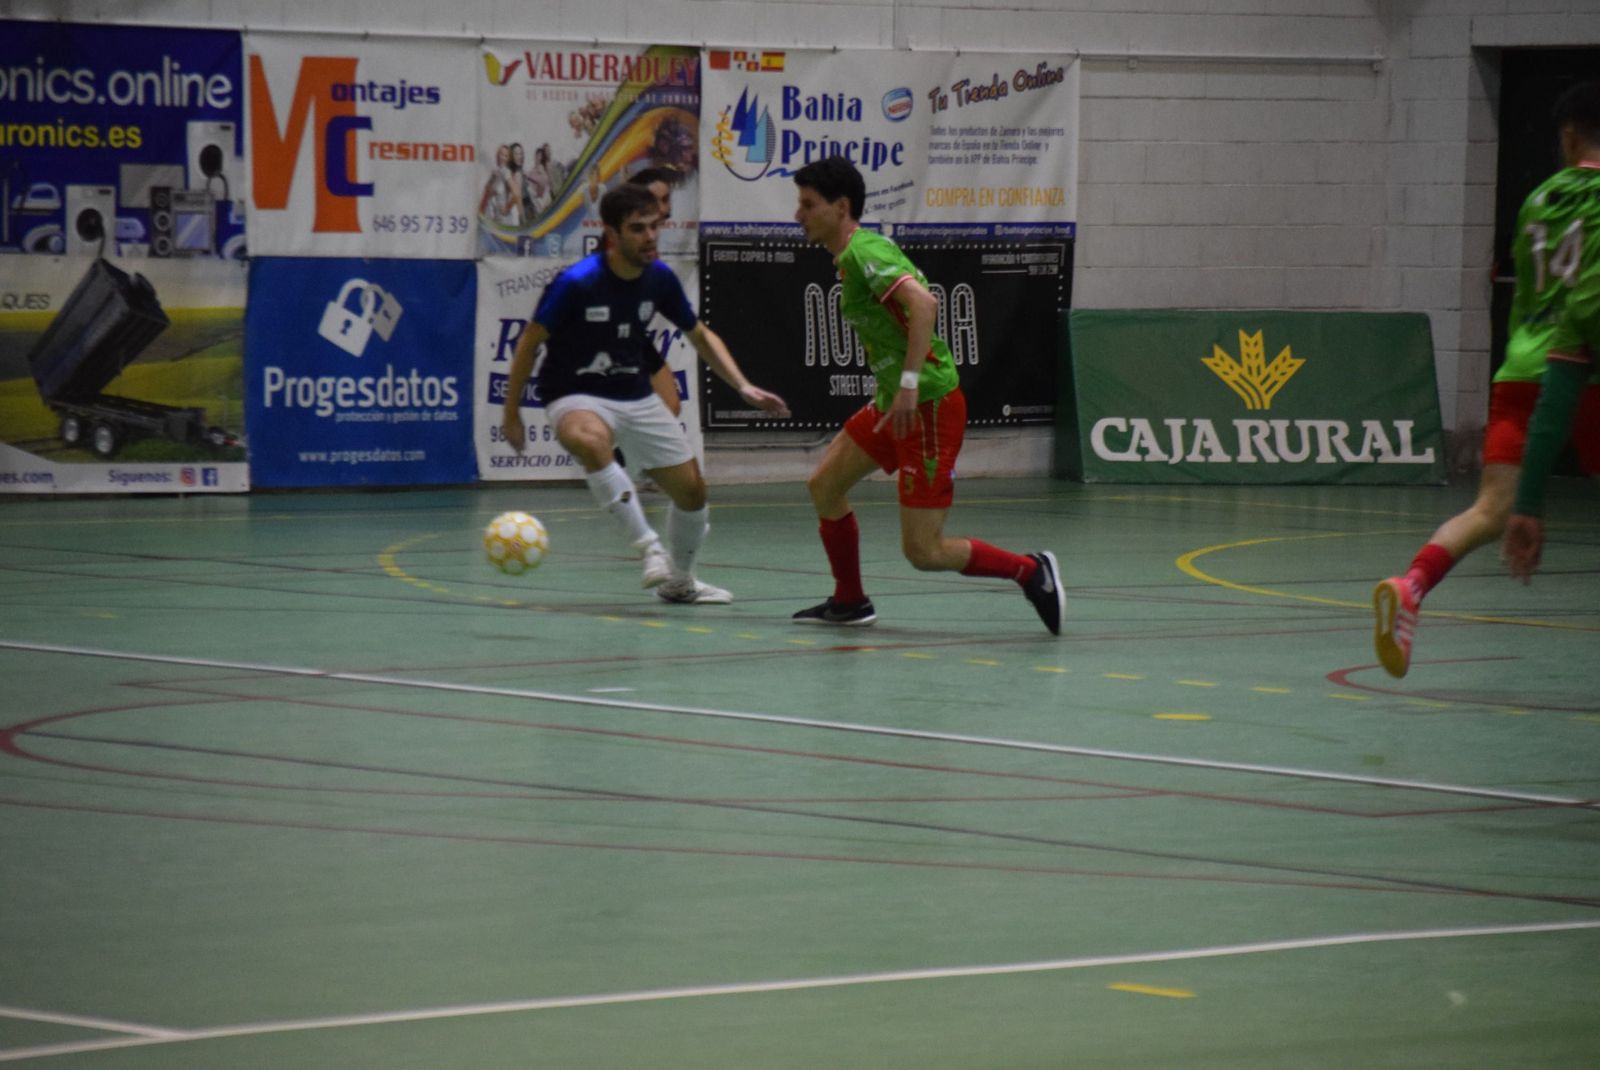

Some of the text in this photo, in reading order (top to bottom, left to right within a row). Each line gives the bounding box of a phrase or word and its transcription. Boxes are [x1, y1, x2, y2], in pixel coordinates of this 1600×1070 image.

[928, 86, 948, 114] Tu
[951, 73, 1008, 108] Tienda
[1012, 61, 1064, 92] Online
[0, 118, 142, 147] ronics.es
[926, 185, 1066, 208] COMPRA EN CONFIANZA
[373, 214, 469, 234] 646 95 73 39
[1523, 217, 1584, 293] 14
[264, 363, 459, 417] Progesdatos
[829, 374, 861, 396] STREET
[1090, 416, 1435, 464] CAJA RURAL
[299, 448, 425, 464] www.progesdatos.com
[489, 455, 573, 468] SERVICIO DE
[0, 472, 54, 484] es.com
